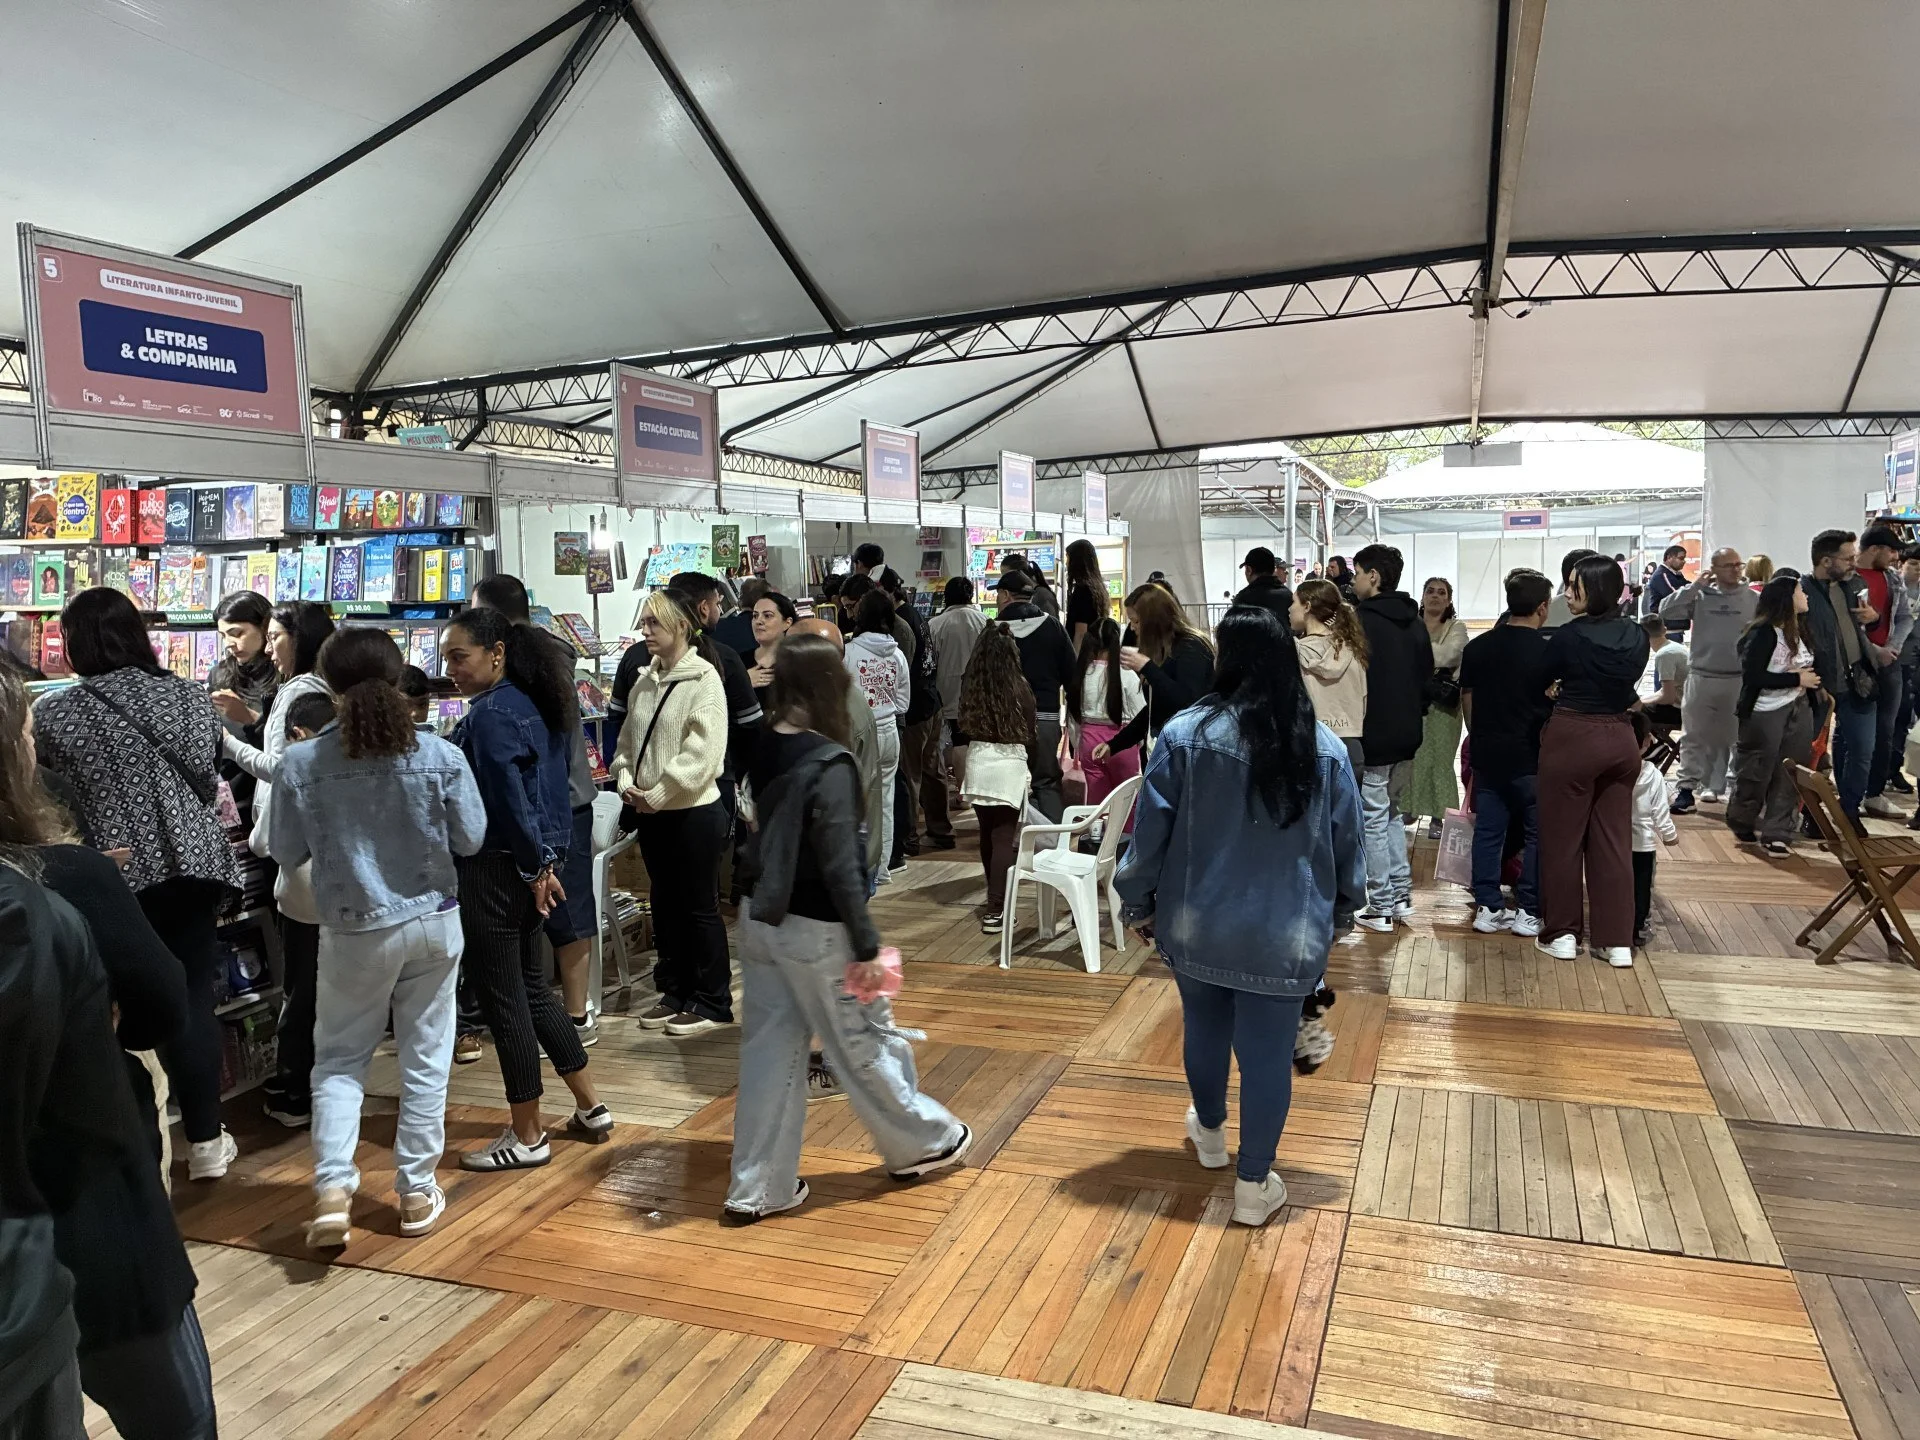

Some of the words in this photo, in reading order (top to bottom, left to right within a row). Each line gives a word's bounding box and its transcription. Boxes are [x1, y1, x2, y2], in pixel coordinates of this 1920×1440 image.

[43, 257, 58, 278] 5
[106, 274, 164, 294] LITERATURA
[165, 286, 238, 308] INFANTO-JUVENIL
[145, 327, 209, 351] LETRAS
[120, 343, 135, 360] &
[138, 345, 238, 374] COMPANHIA
[621, 381, 627, 394] 4
[639, 421, 668, 436] ESTAÇÃO
[669, 426, 699, 441] CULTURAL
[198, 493, 220, 502] HOMEM
[319, 495, 337, 510] Heidi
[202, 504, 216, 513] GIZ
[291, 504, 308, 519] POE
